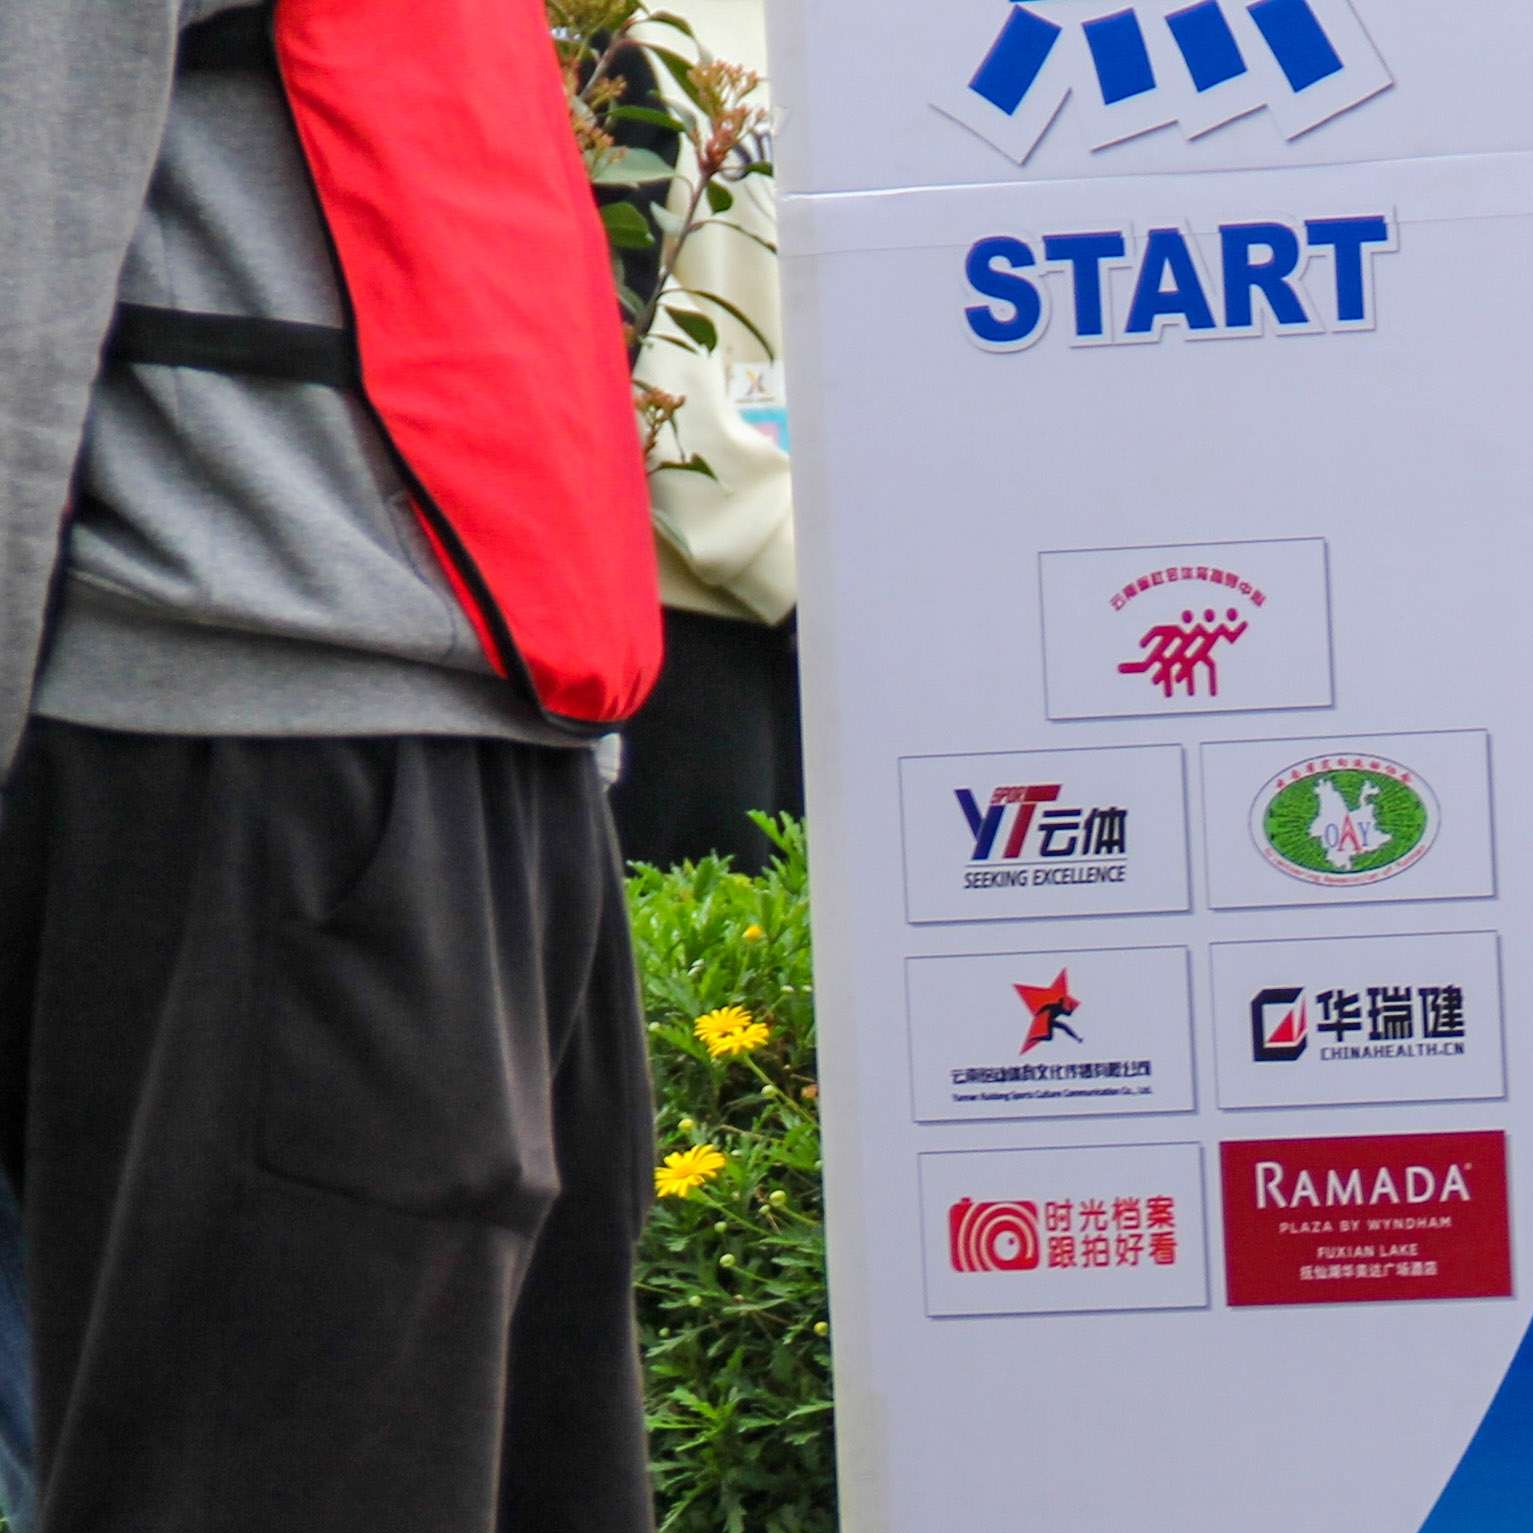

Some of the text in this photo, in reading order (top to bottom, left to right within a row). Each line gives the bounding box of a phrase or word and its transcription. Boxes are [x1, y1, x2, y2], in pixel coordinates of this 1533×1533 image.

[963, 214, 1389, 345] START
[1037, 806, 1128, 857] 云体
[963, 865, 1127, 889] SEEKING EXCELLENCE
[1315, 984, 1466, 1042] 华瑞健
[1254, 1160, 1471, 1209] RAMADA
[1044, 1194, 1175, 1231] 时光档案
[1279, 1215, 1453, 1234] PLAZA BY WYNDHAM
[1047, 1231, 1177, 1269] 跟拍好看
[1316, 1243, 1419, 1260] FUXIAN LAKE
